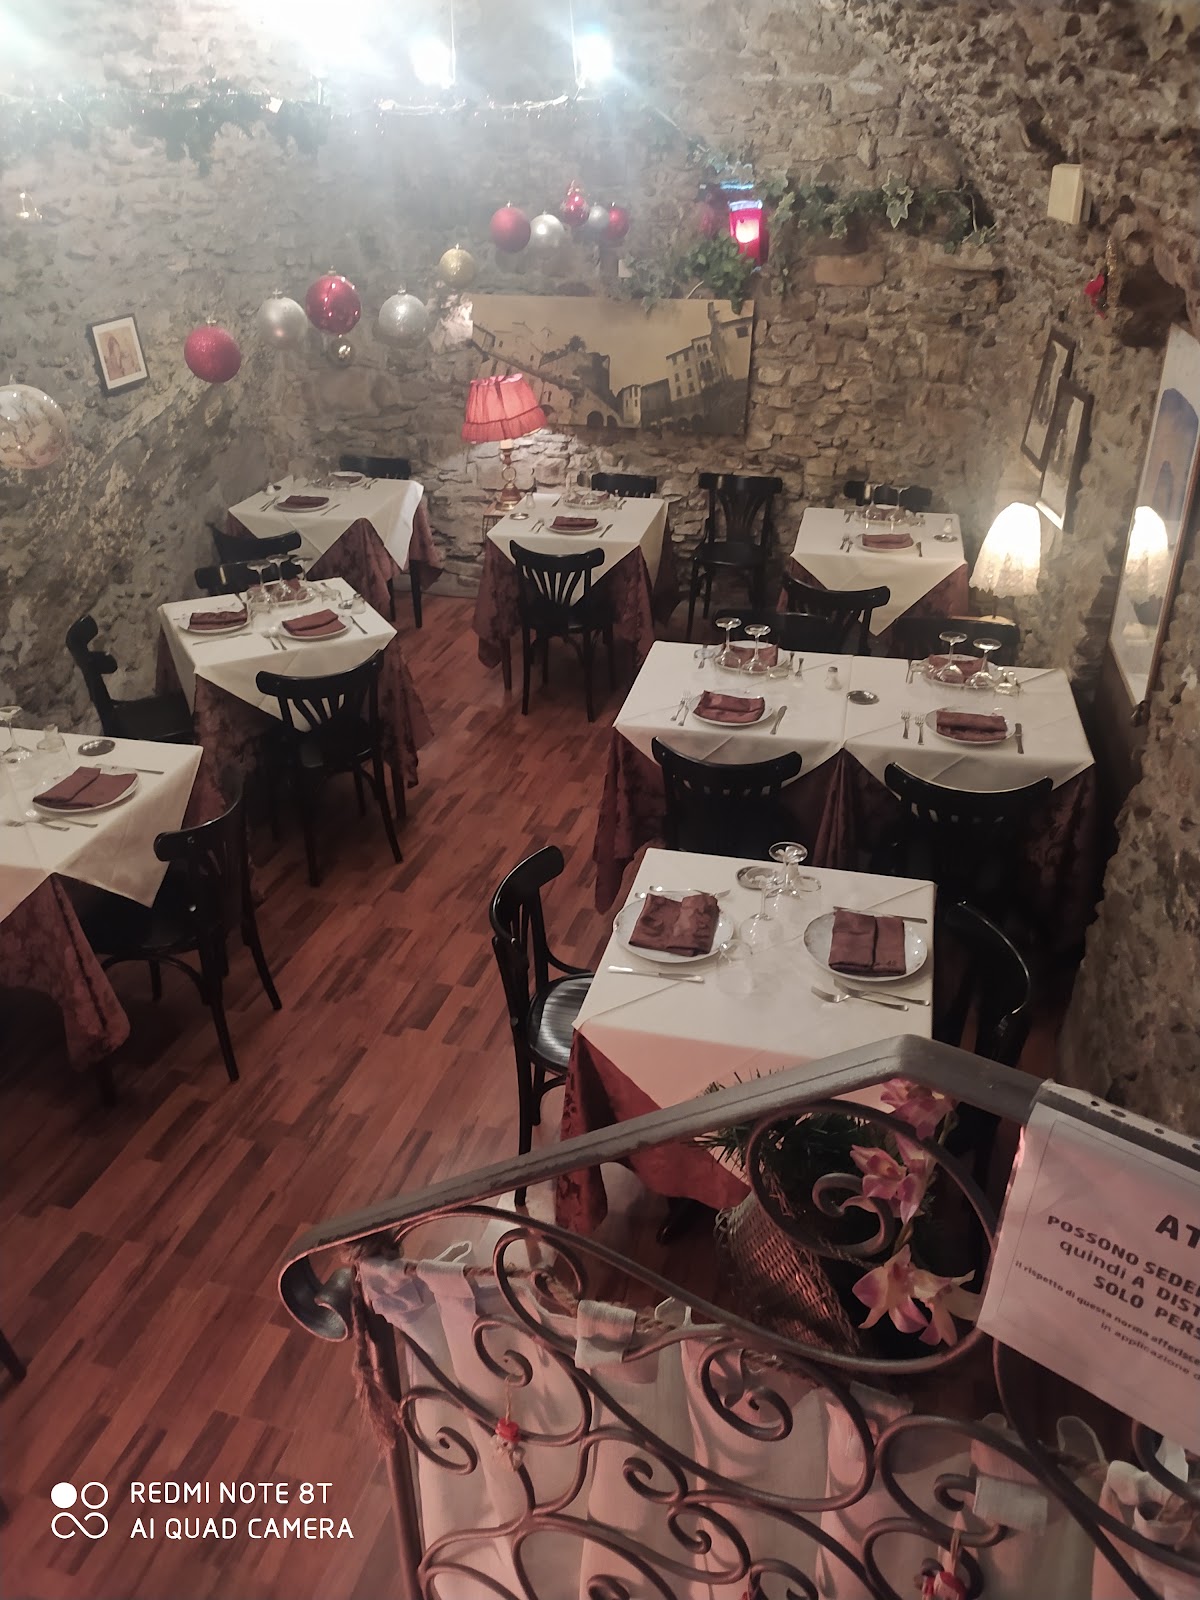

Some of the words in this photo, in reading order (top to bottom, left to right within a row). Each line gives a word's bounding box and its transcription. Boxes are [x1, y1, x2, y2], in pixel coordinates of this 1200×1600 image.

[1047, 1215, 1139, 1266] POSSONO
[1060, 1240, 1127, 1280] quindi
[1131, 1276, 1145, 1289] A
[1024, 1266, 1063, 1291] rispetto
[1065, 1289, 1075, 1298] di
[1077, 1297, 1112, 1318] questa
[1114, 1316, 1149, 1337] norma
[1093, 1275, 1144, 1309] SOLO
[1115, 1331, 1189, 1374] applicazione
